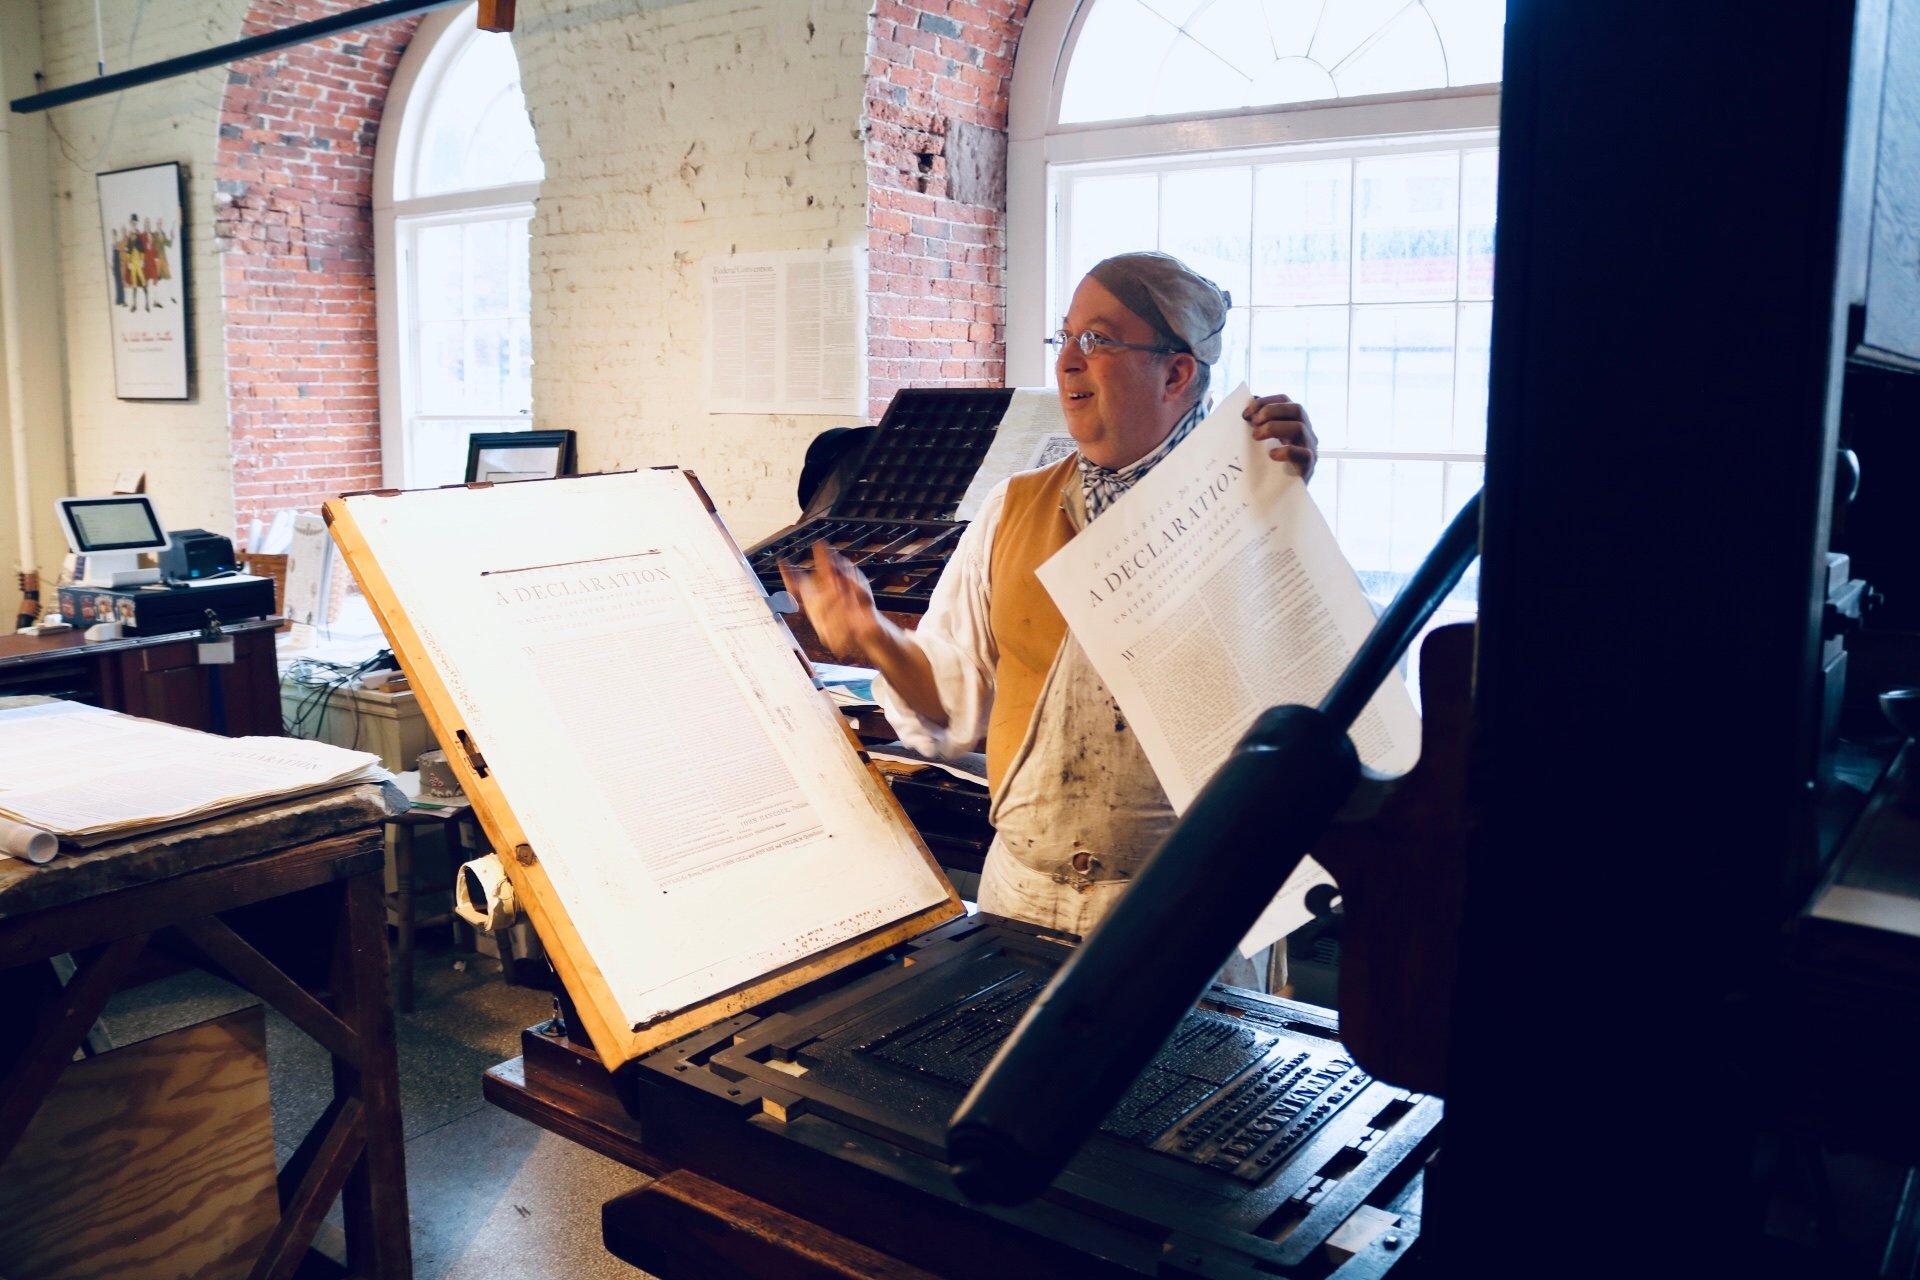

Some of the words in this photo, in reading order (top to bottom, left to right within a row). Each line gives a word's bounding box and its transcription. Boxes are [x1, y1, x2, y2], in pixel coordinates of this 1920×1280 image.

[1089, 589, 1104, 608] A
[1104, 456, 1244, 592] DECLARATION
[495, 590, 510, 607] A
[513, 567, 672, 602] DECLARATION
